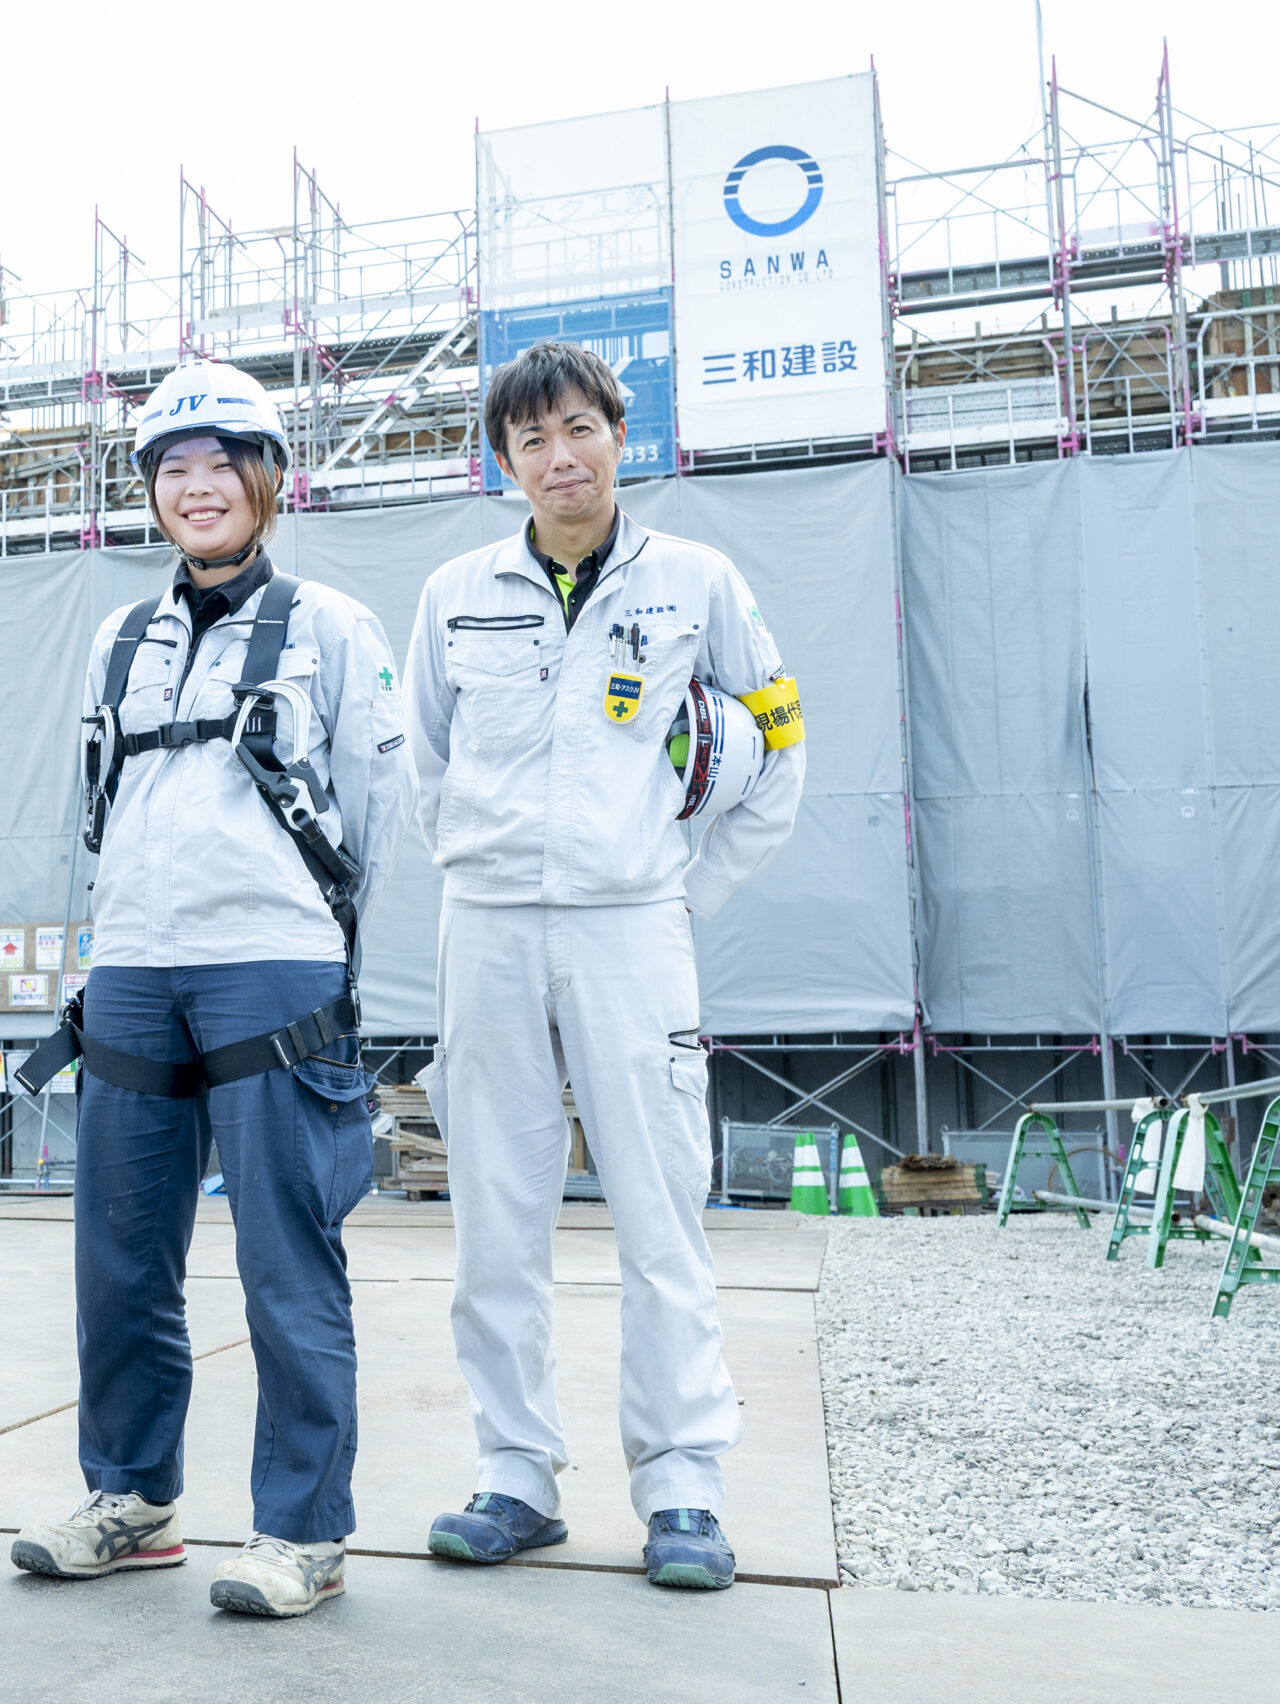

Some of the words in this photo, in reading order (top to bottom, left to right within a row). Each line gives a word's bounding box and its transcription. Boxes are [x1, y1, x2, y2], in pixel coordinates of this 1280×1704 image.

[720, 249, 829, 279] SANWA
[702, 340, 858, 385] 三和建設
[169, 394, 208, 416] JV
[623, 444, 658, 464] 333
[708, 756, 722, 778] 本山
